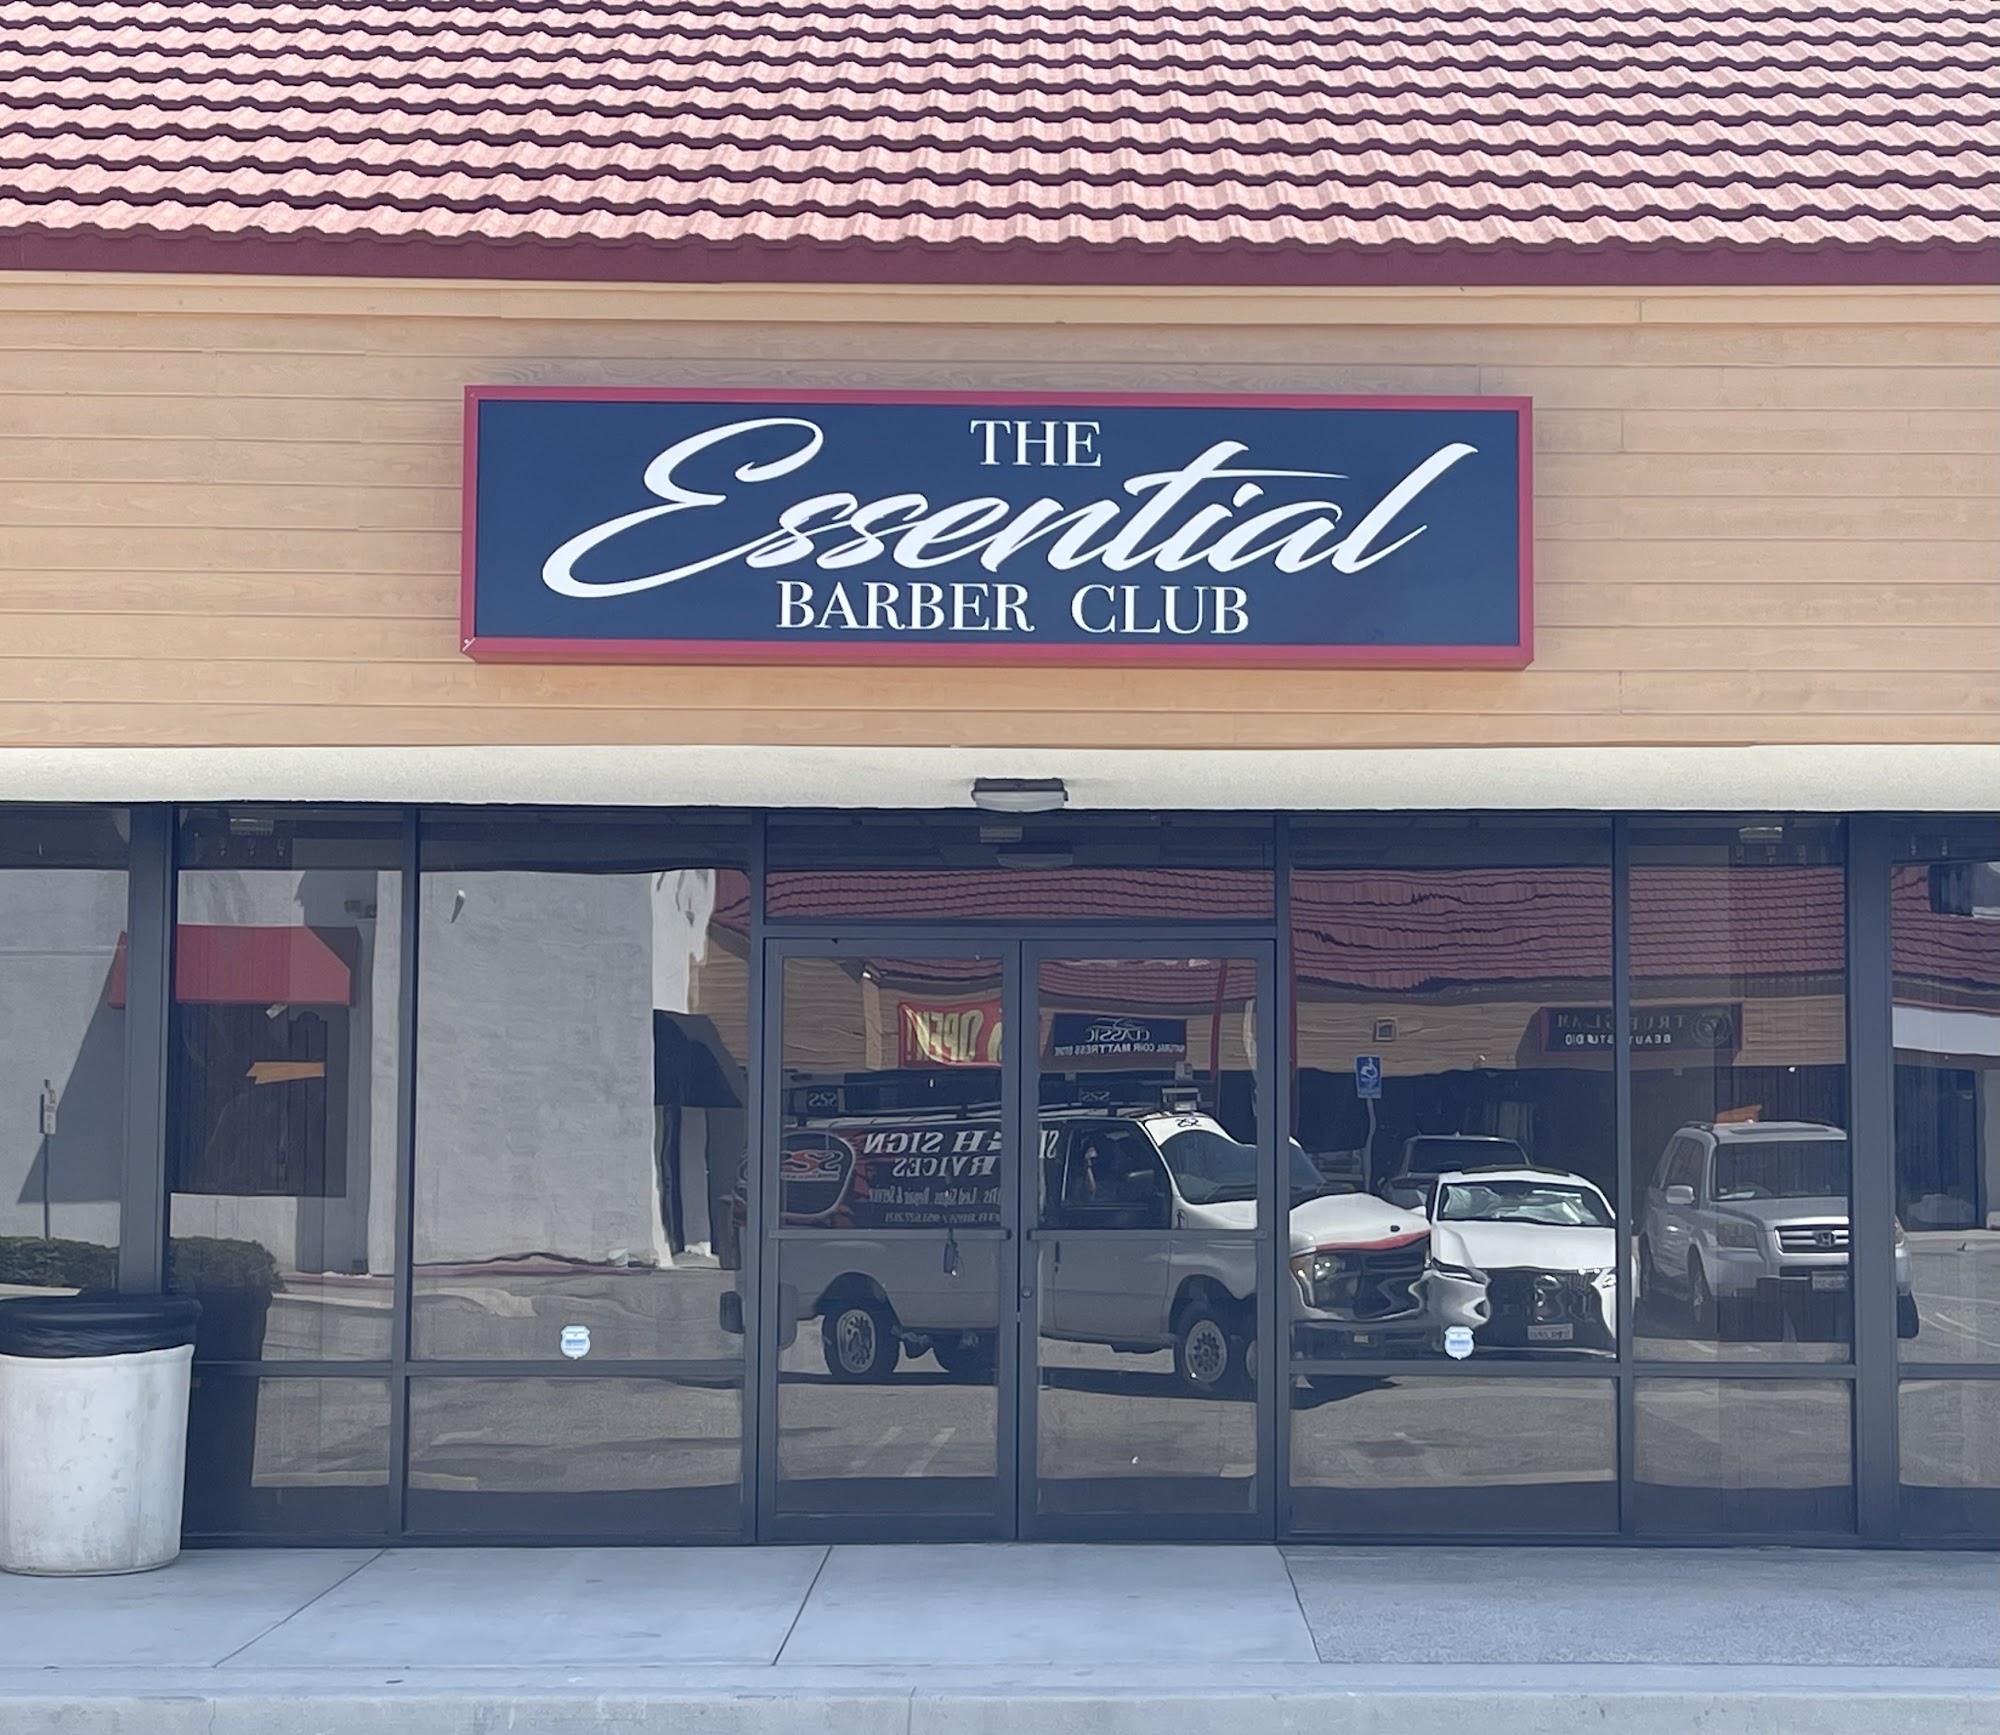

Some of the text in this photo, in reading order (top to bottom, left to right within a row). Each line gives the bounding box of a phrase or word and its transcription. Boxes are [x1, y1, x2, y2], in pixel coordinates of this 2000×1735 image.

[970, 420, 1101, 467] THE
[542, 418, 1479, 598] Essential
[776, 580, 1249, 634] BARBER CLUB
